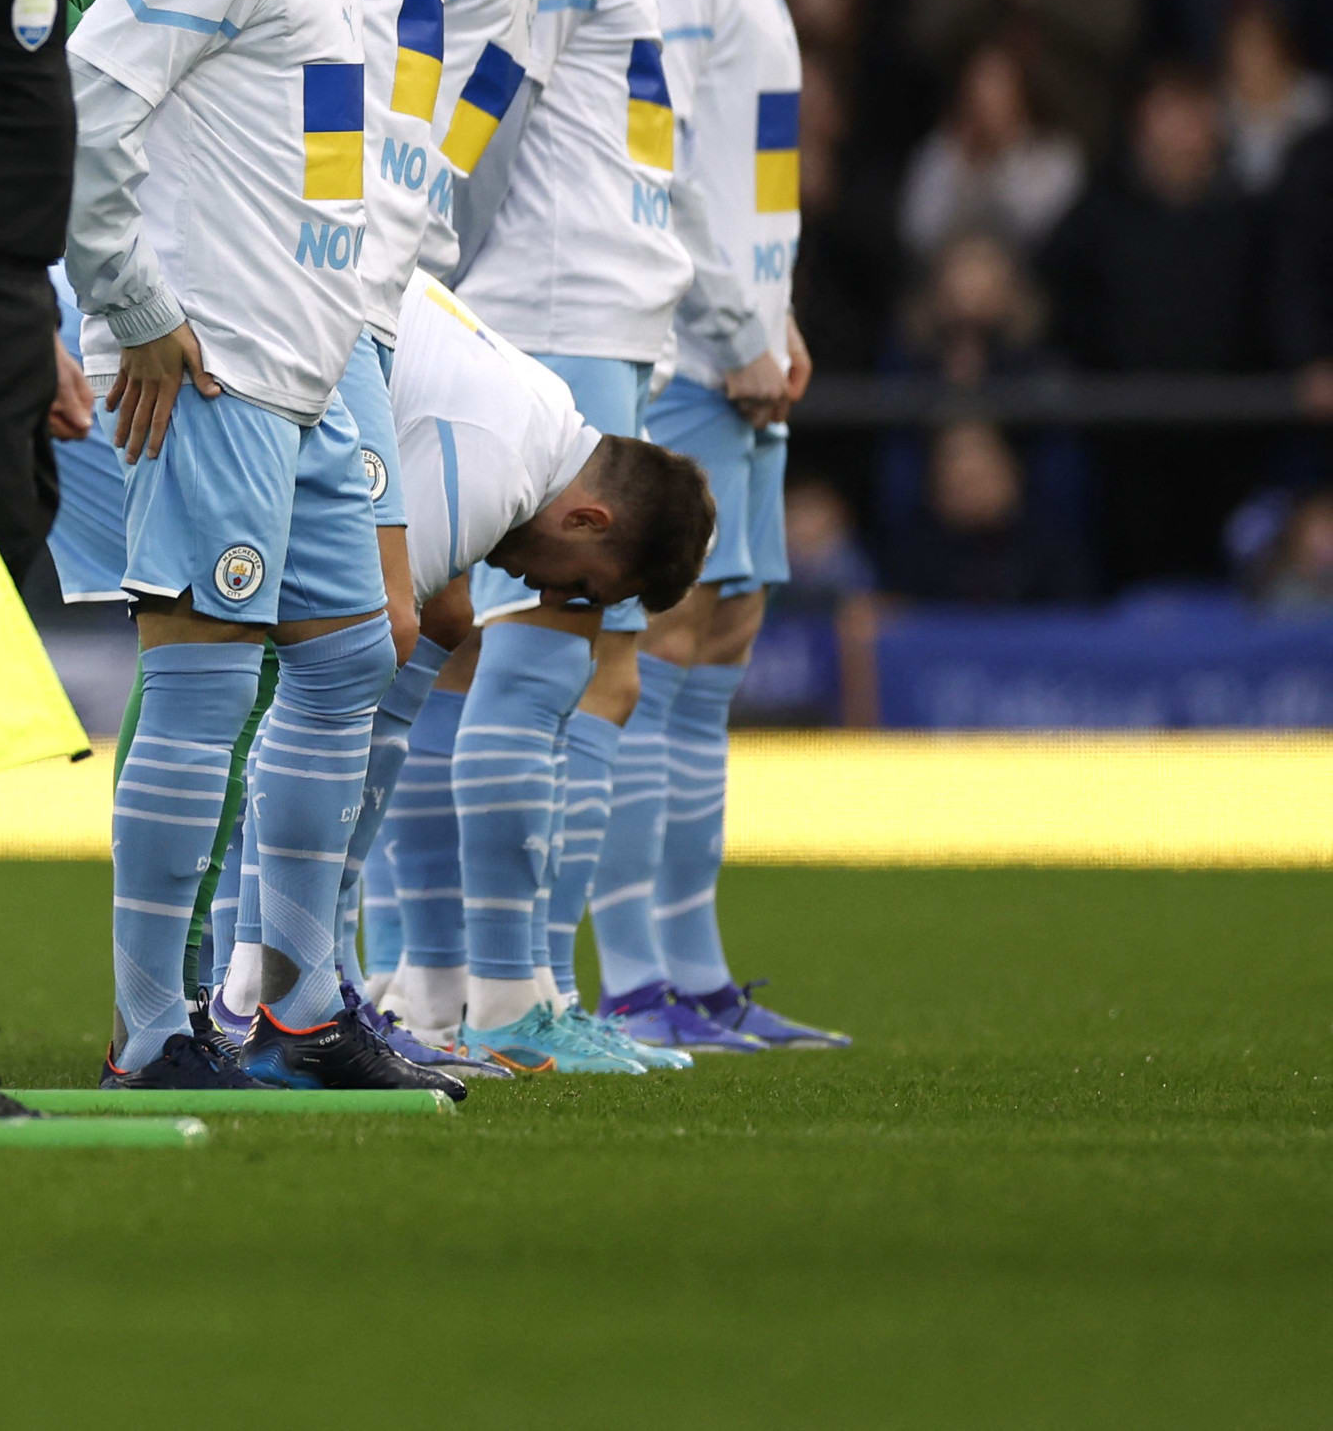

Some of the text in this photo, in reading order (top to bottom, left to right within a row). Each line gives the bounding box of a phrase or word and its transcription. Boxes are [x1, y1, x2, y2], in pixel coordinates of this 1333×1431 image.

[381, 137, 427, 190] NO
[632, 181, 669, 229] NO
[295, 222, 350, 270] NO
[753, 233, 784, 282] NO
[223, 549, 261, 569] MANCHESTER
[319, 1032, 341, 1046] COPA
